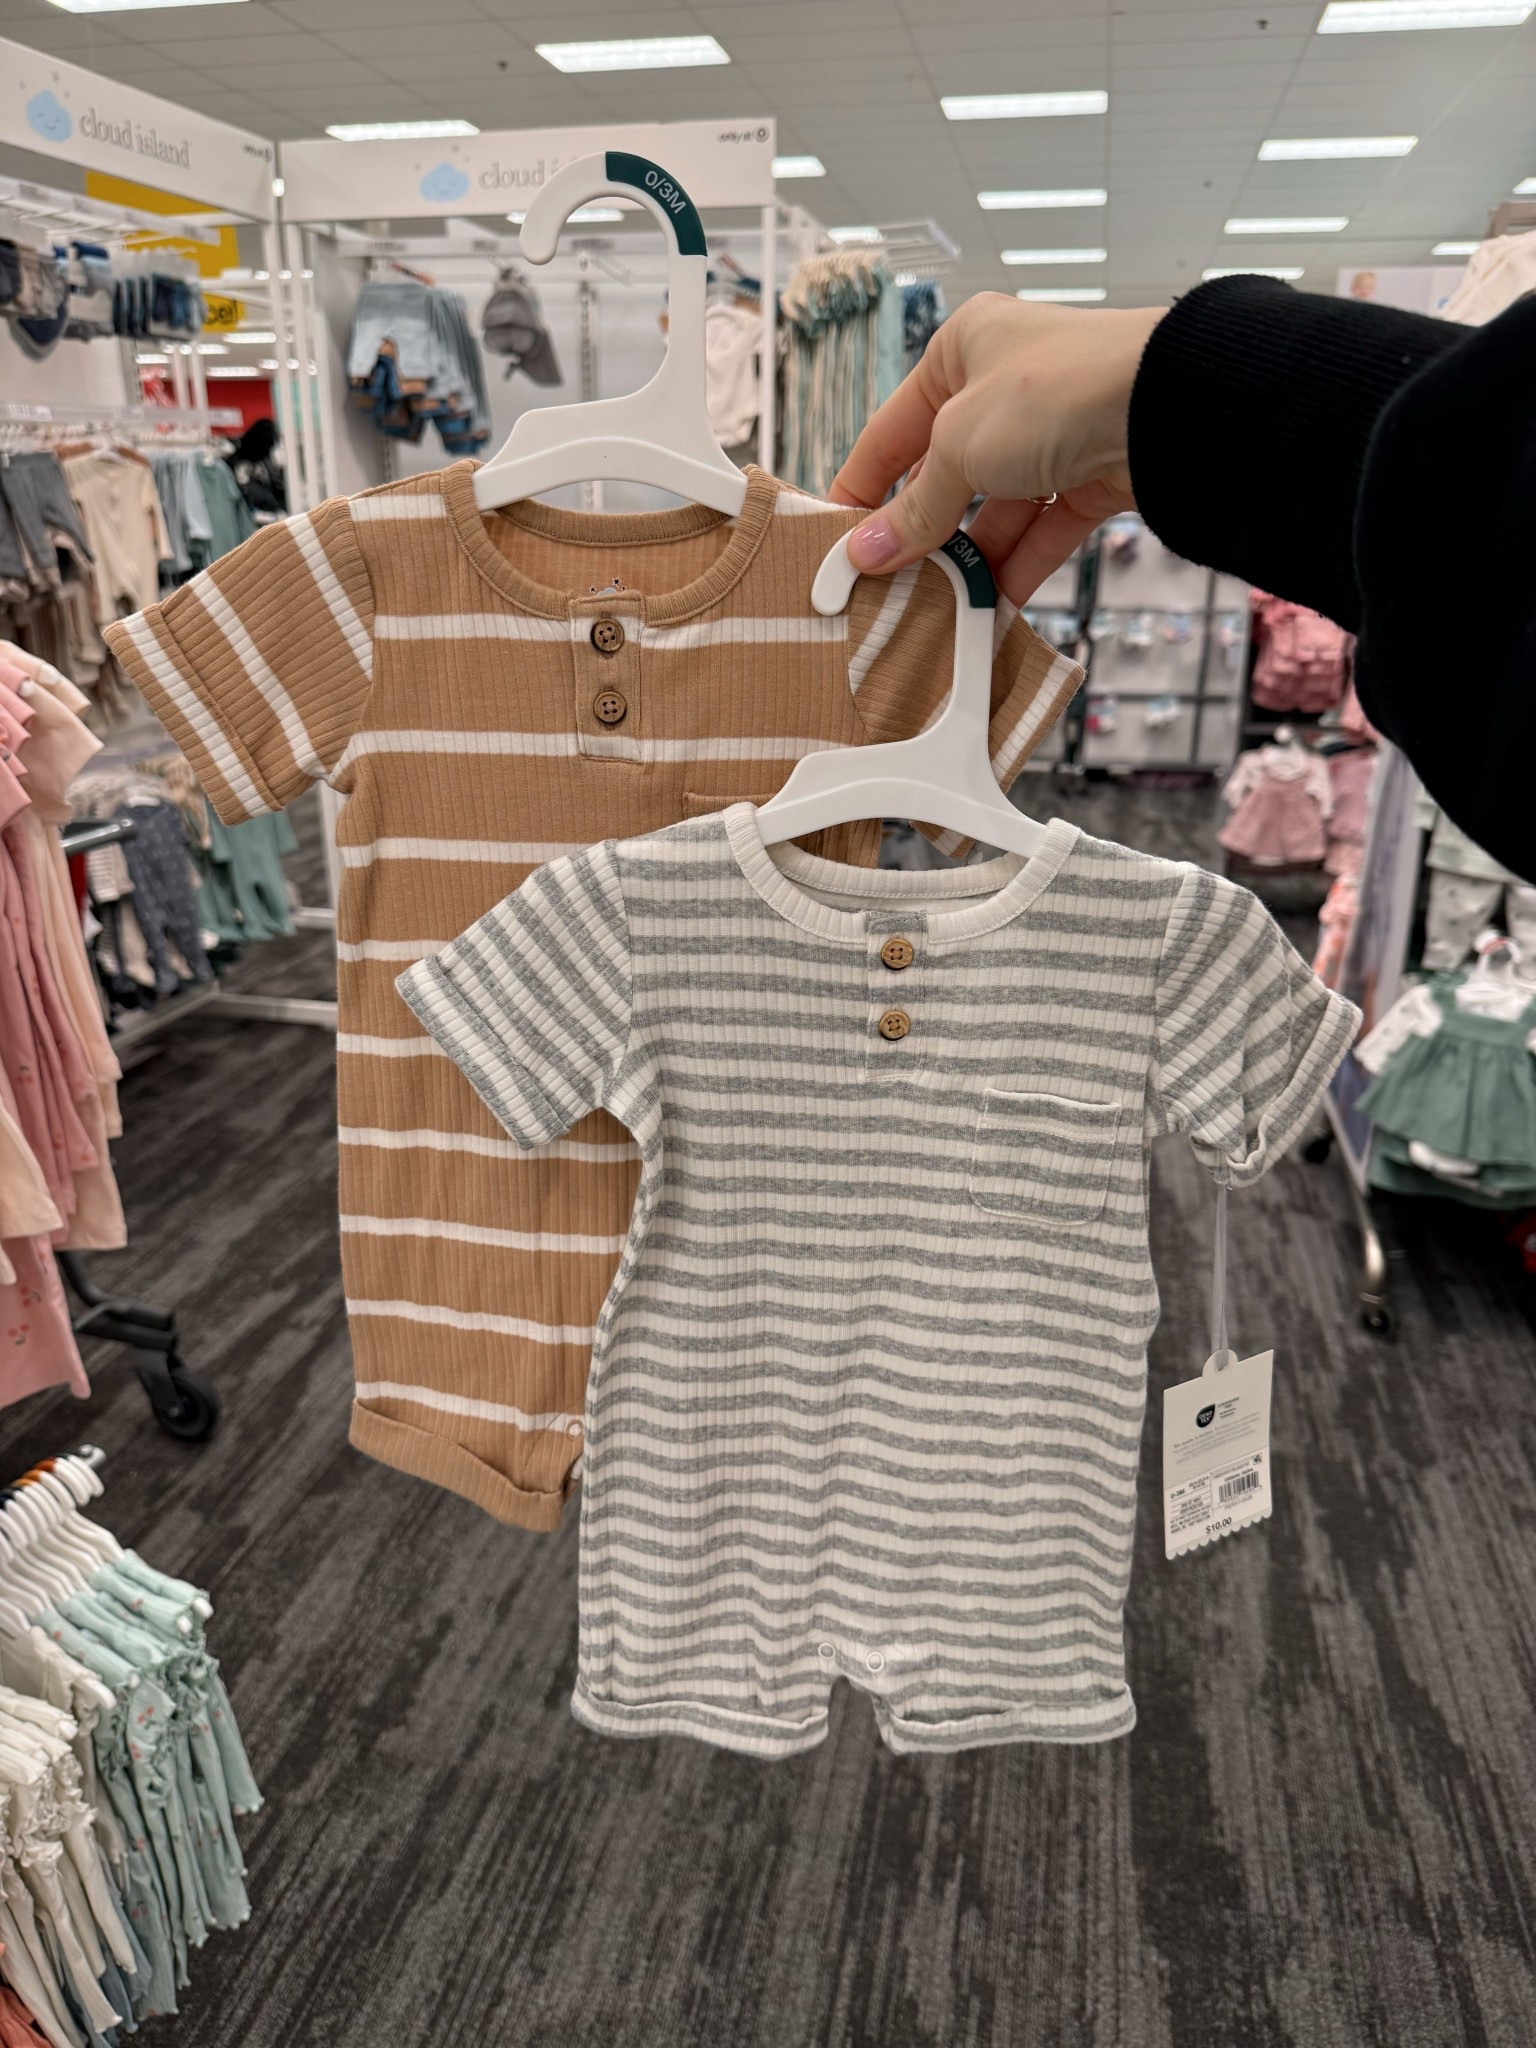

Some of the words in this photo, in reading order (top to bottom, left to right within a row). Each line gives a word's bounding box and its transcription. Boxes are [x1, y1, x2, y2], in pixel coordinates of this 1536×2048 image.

[79, 106, 133, 150] cloud
[136, 123, 191, 169] island
[478, 159, 546, 189] cloud
[645, 170, 686, 214] 0/3M
[947, 535, 980, 568] /3M
[1205, 1516, 1232, 1534] $10.00
